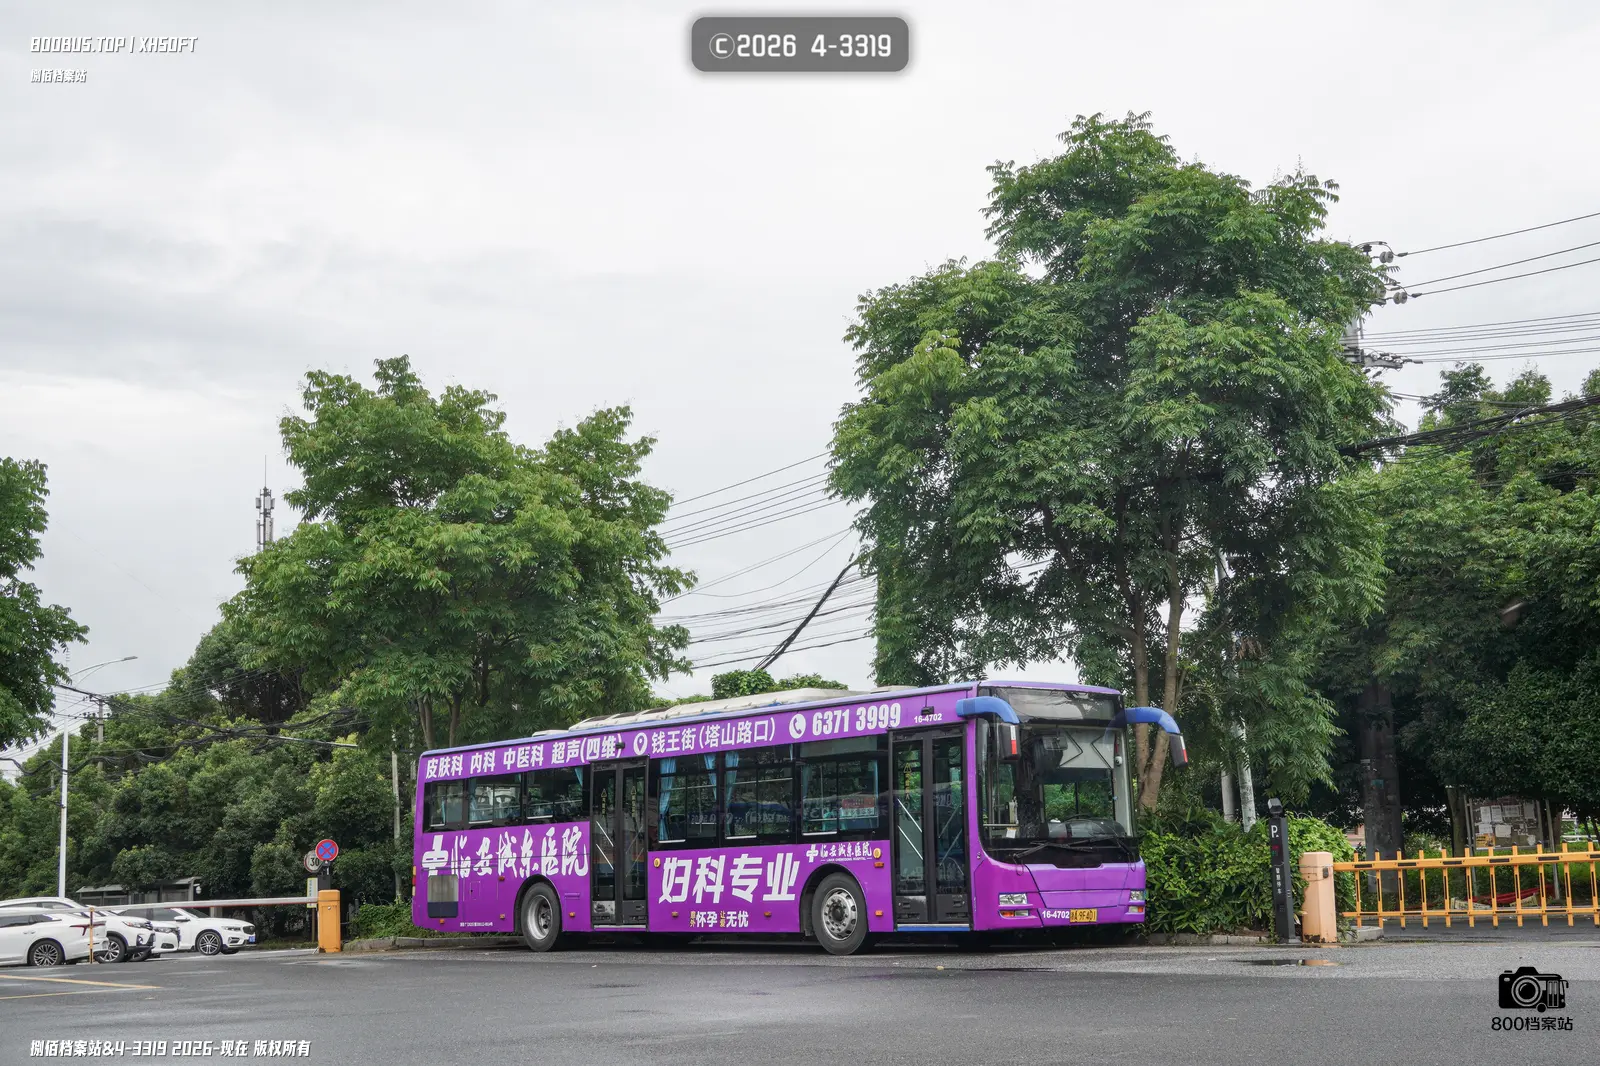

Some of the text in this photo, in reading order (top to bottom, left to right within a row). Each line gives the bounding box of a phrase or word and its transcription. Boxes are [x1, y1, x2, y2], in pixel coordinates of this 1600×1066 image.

[914, 713, 942, 723] 16-4702
[426, 754, 463, 779] 皮肤科
[470, 750, 496, 774] 内科
[503, 744, 544, 770] 中医科
[652, 717, 775, 755] 钱王街(塔山路口)
[812, 709, 849, 736] 6371
[856, 703, 901, 732] 3999
[310, 857, 320, 867] 30
[658, 852, 800, 904] 妇科专业
[1042, 910, 1070, 919] 16-4702
